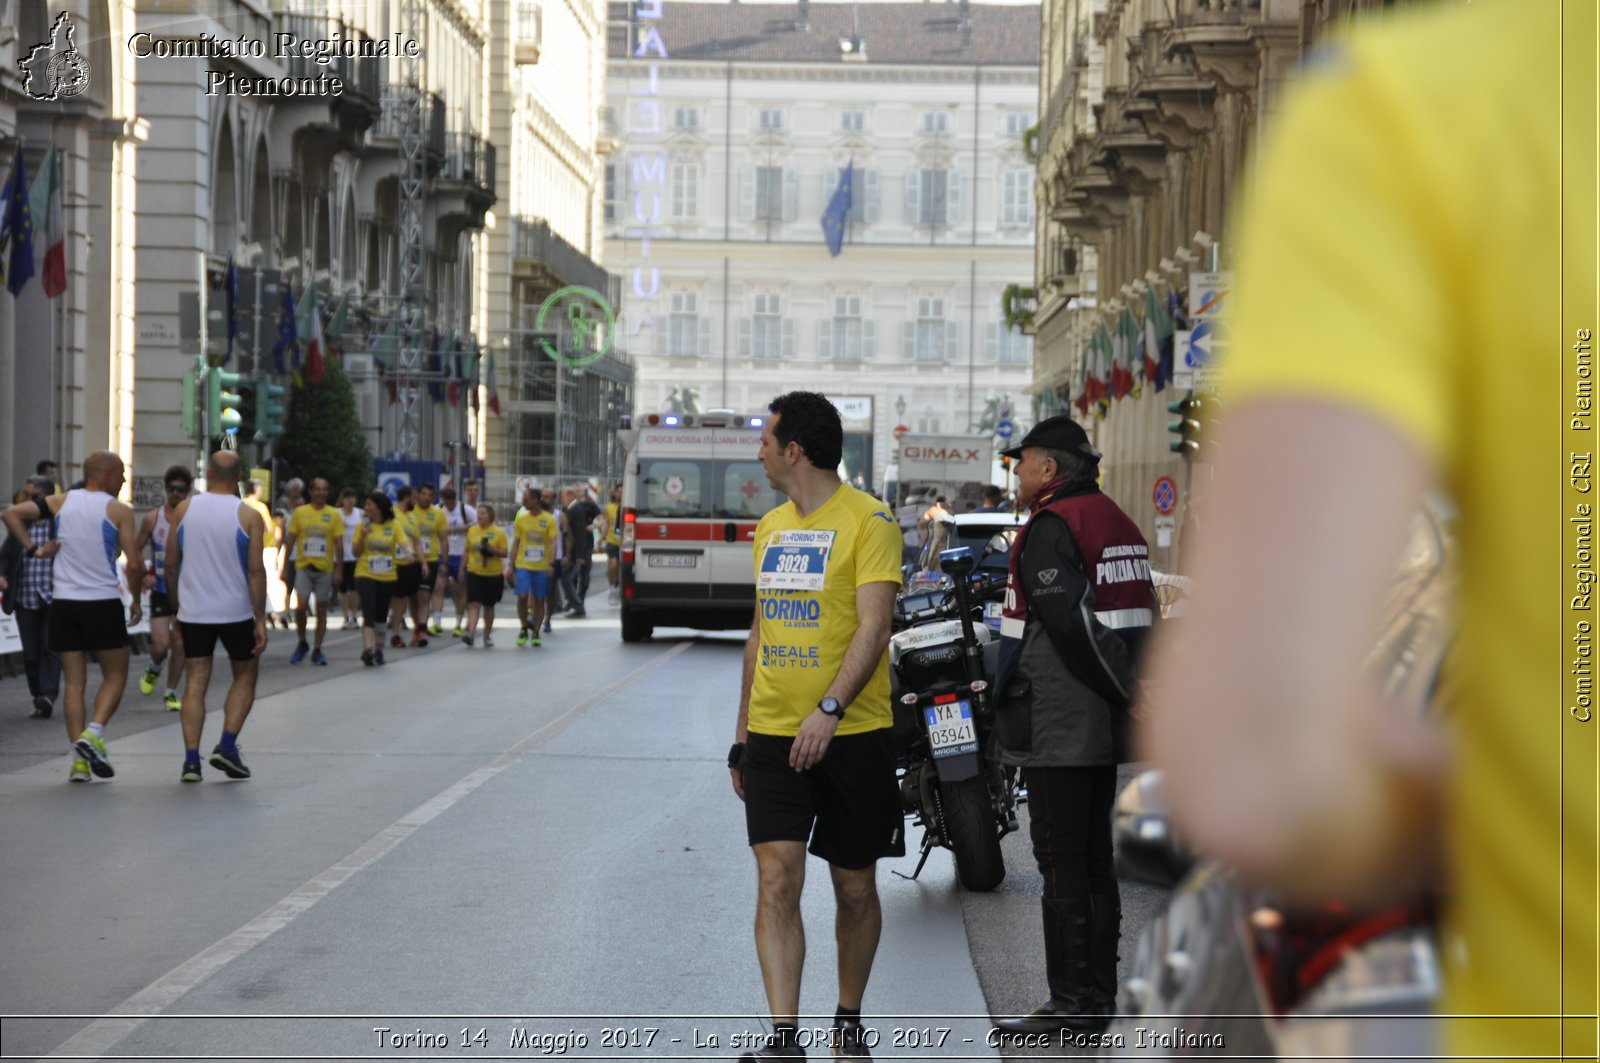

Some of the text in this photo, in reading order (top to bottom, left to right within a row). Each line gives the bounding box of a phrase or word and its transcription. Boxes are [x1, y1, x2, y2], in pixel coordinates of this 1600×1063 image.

[646, 436, 672, 444] CROCE
[675, 436, 701, 444] ROSSA
[704, 436, 737, 445] ITALIANA
[904, 447, 979, 460] GIMAX
[776, 554, 809, 573] 3028
[760, 598, 820, 620] TORINO
[909, 633, 929, 644] POLIZIA
[770, 645, 819, 658] REALE
[770, 659, 820, 668] MUTUA
[936, 705, 954, 721] YA
[931, 725, 971, 746] 03941
[934, 746, 959, 756] MAGIC
